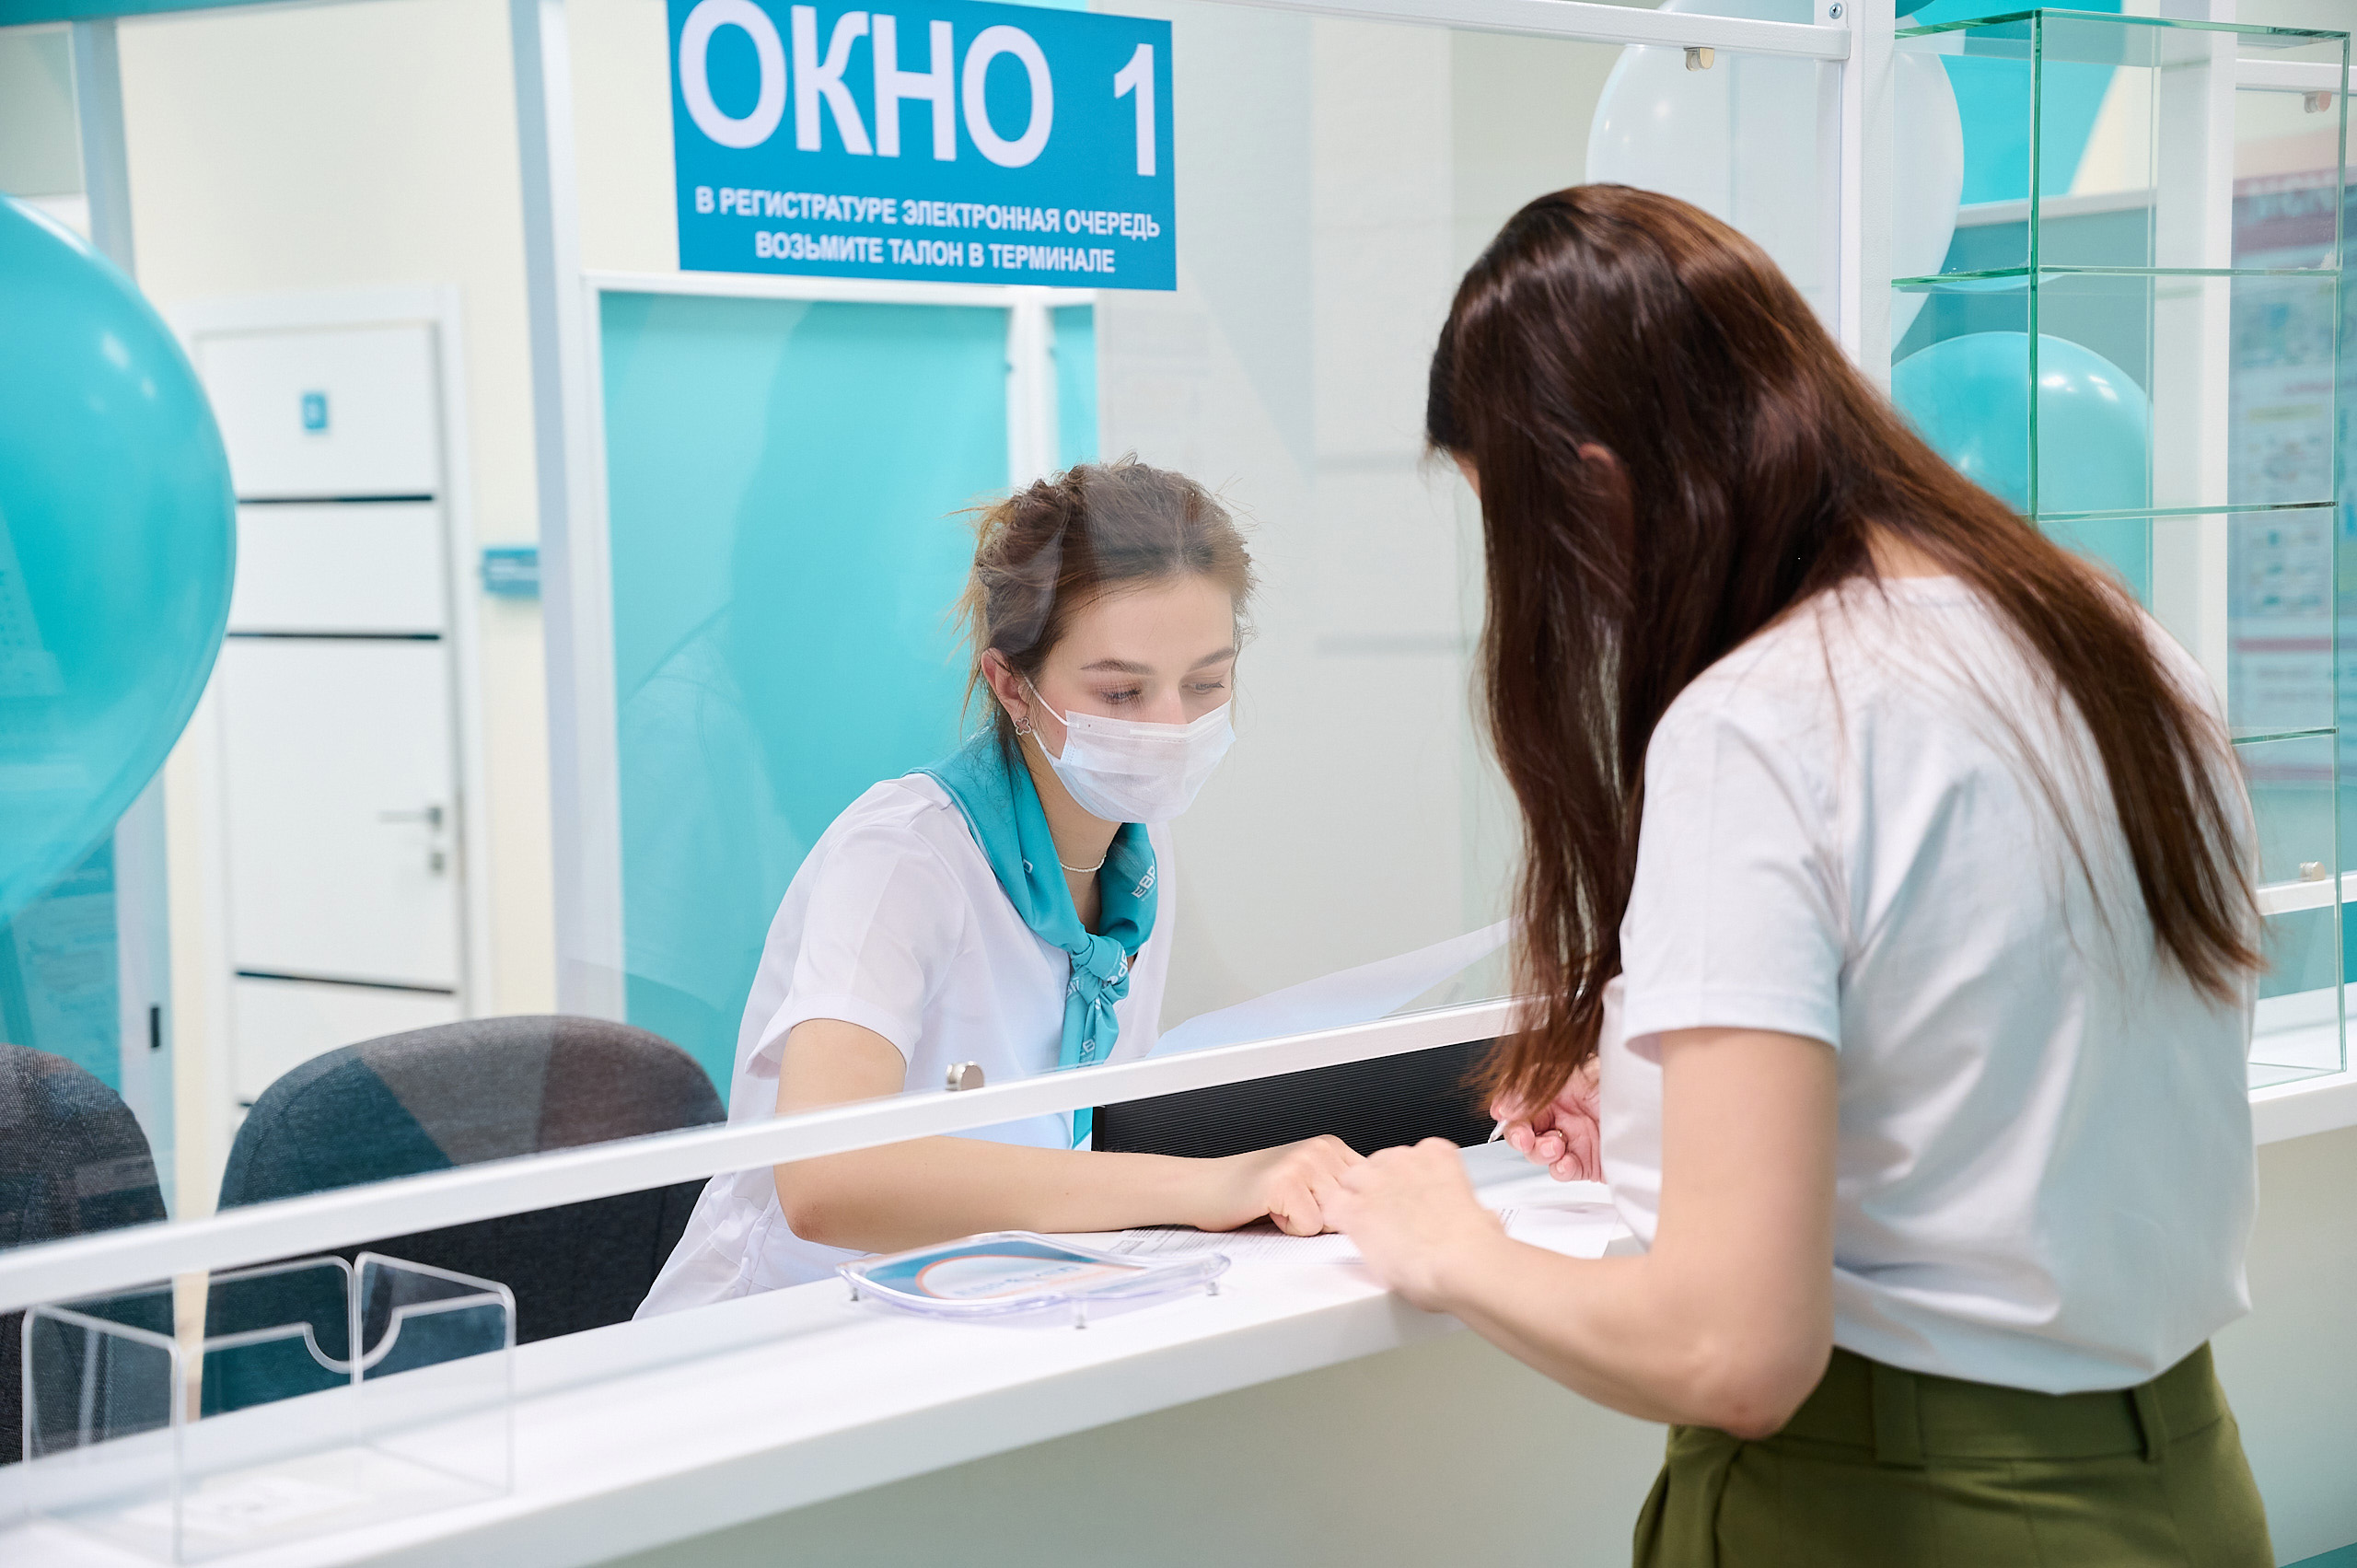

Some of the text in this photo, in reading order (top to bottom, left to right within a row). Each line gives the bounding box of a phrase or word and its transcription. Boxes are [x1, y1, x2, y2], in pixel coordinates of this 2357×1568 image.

[679, 0, 1156, 177] ОКНО 1
[695, 185, 1161, 241] В РЕГИСТРАТУРЕ ЭЛЕКТРОННАЯ ОЧЕРЕДЬ
[755, 230, 1116, 273] ВОЗЬМИТЕ ТАЛОН В ТЕРМИНАЛЕ
